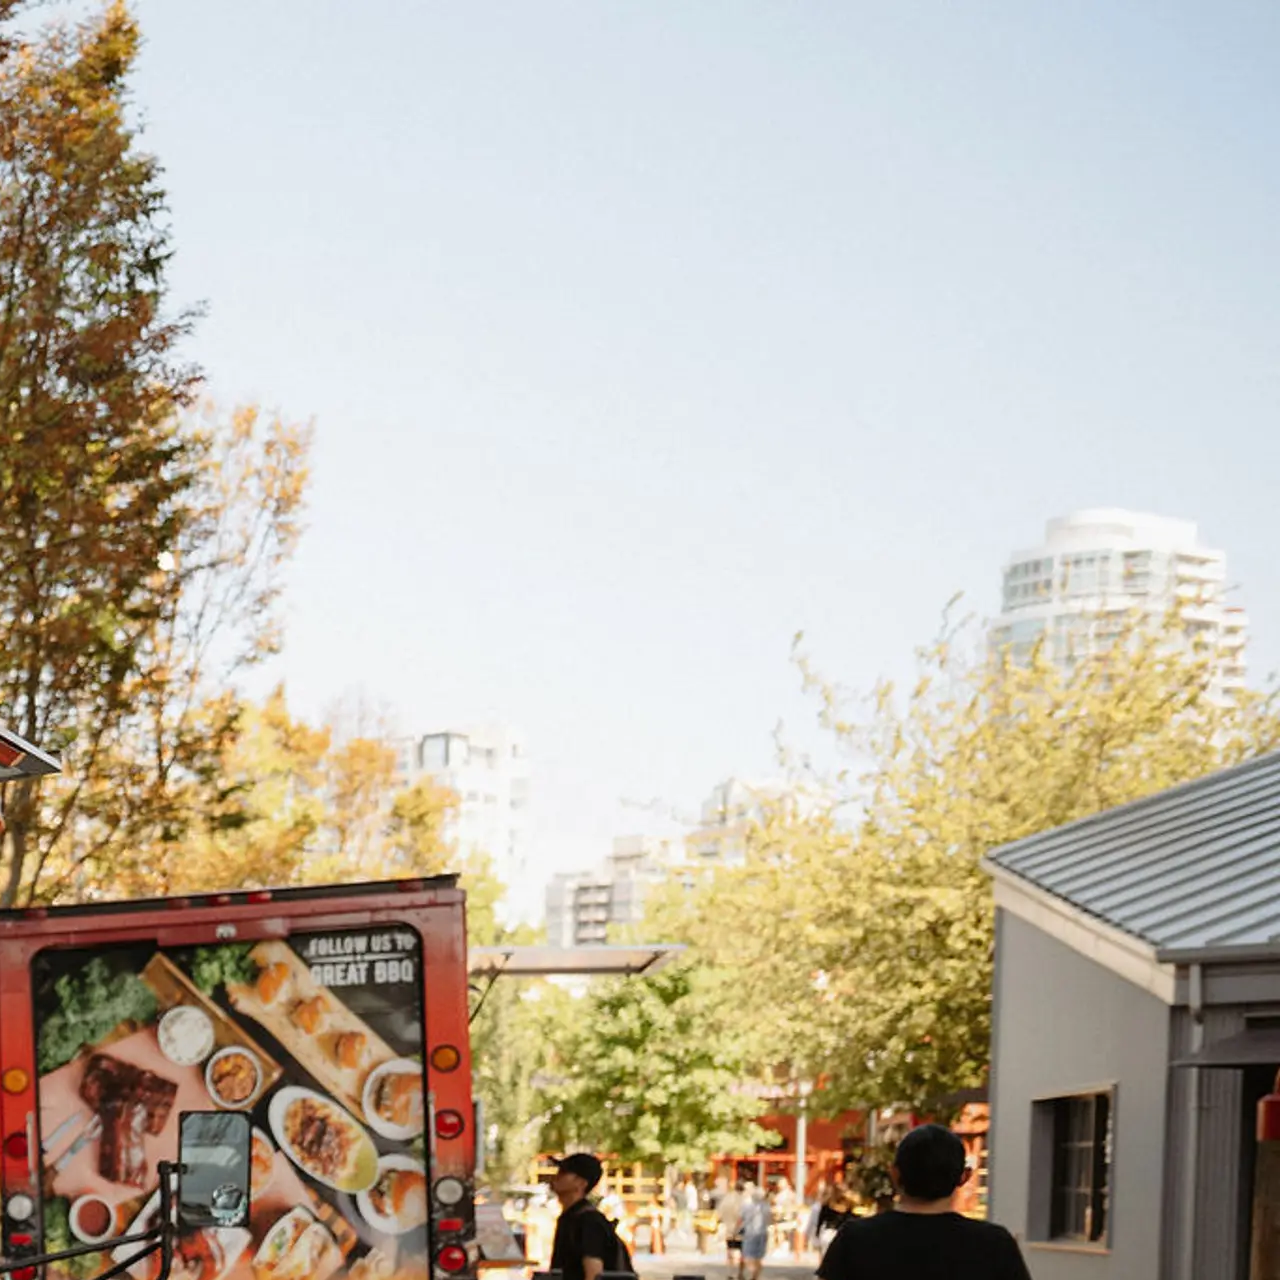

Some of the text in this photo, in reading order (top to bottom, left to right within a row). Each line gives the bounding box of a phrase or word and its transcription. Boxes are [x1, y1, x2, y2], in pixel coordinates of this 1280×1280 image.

[308, 932, 417, 956] FOLLOW US TO
[310, 959, 414, 986] GREAT BBQ
